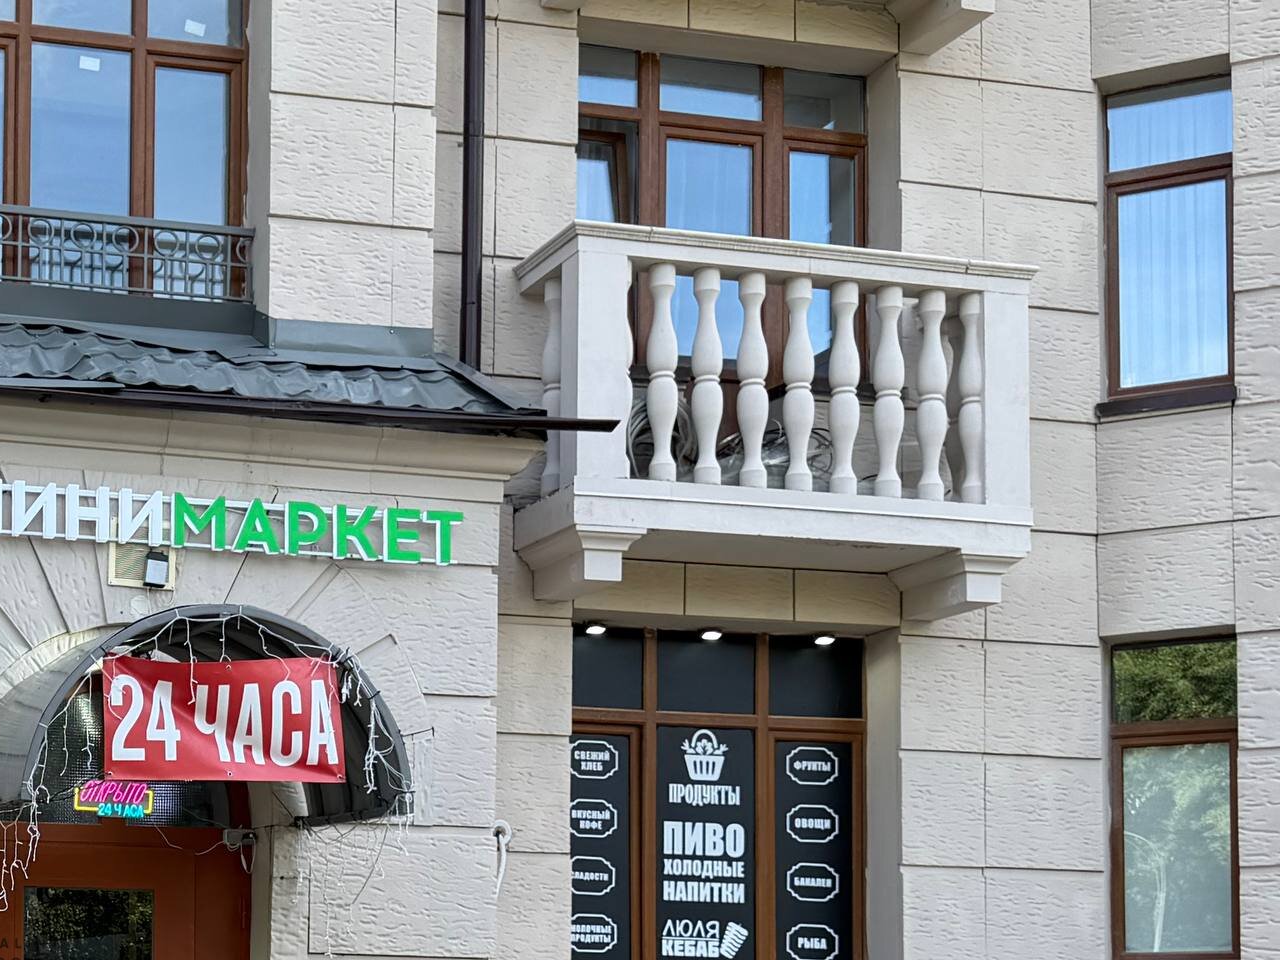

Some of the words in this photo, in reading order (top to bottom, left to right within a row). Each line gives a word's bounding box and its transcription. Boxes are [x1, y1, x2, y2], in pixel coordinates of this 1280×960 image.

[111, 674, 181, 761] 24
[193, 679, 339, 767] ЧАСА
[574, 750, 610, 761] СВЕЖИЙ
[580, 761, 603, 771] ХЛЕБ
[793, 760, 831, 772] ФРУКТЫ
[80, 779, 147, 804] ОТКРЫТО
[668, 783, 741, 806] ПРОДУКТЫ
[97, 802, 112, 816] 24
[114, 803, 144, 818] ЧАСА
[571, 809, 611, 820] ВКУСНЫЙ
[579, 820, 602, 830] КОФЕ
[794, 818, 831, 830] ОВОЩИ
[663, 820, 745, 858] ПИВО
[663, 858, 745, 879] ХОЛОДНЫЕ
[663, 880, 745, 904] НАПИТКИ
[662, 919, 720, 938] ЛЮЛЯ
[661, 939, 720, 958] КЕБАБ
[797, 937, 828, 950] РЫБА
